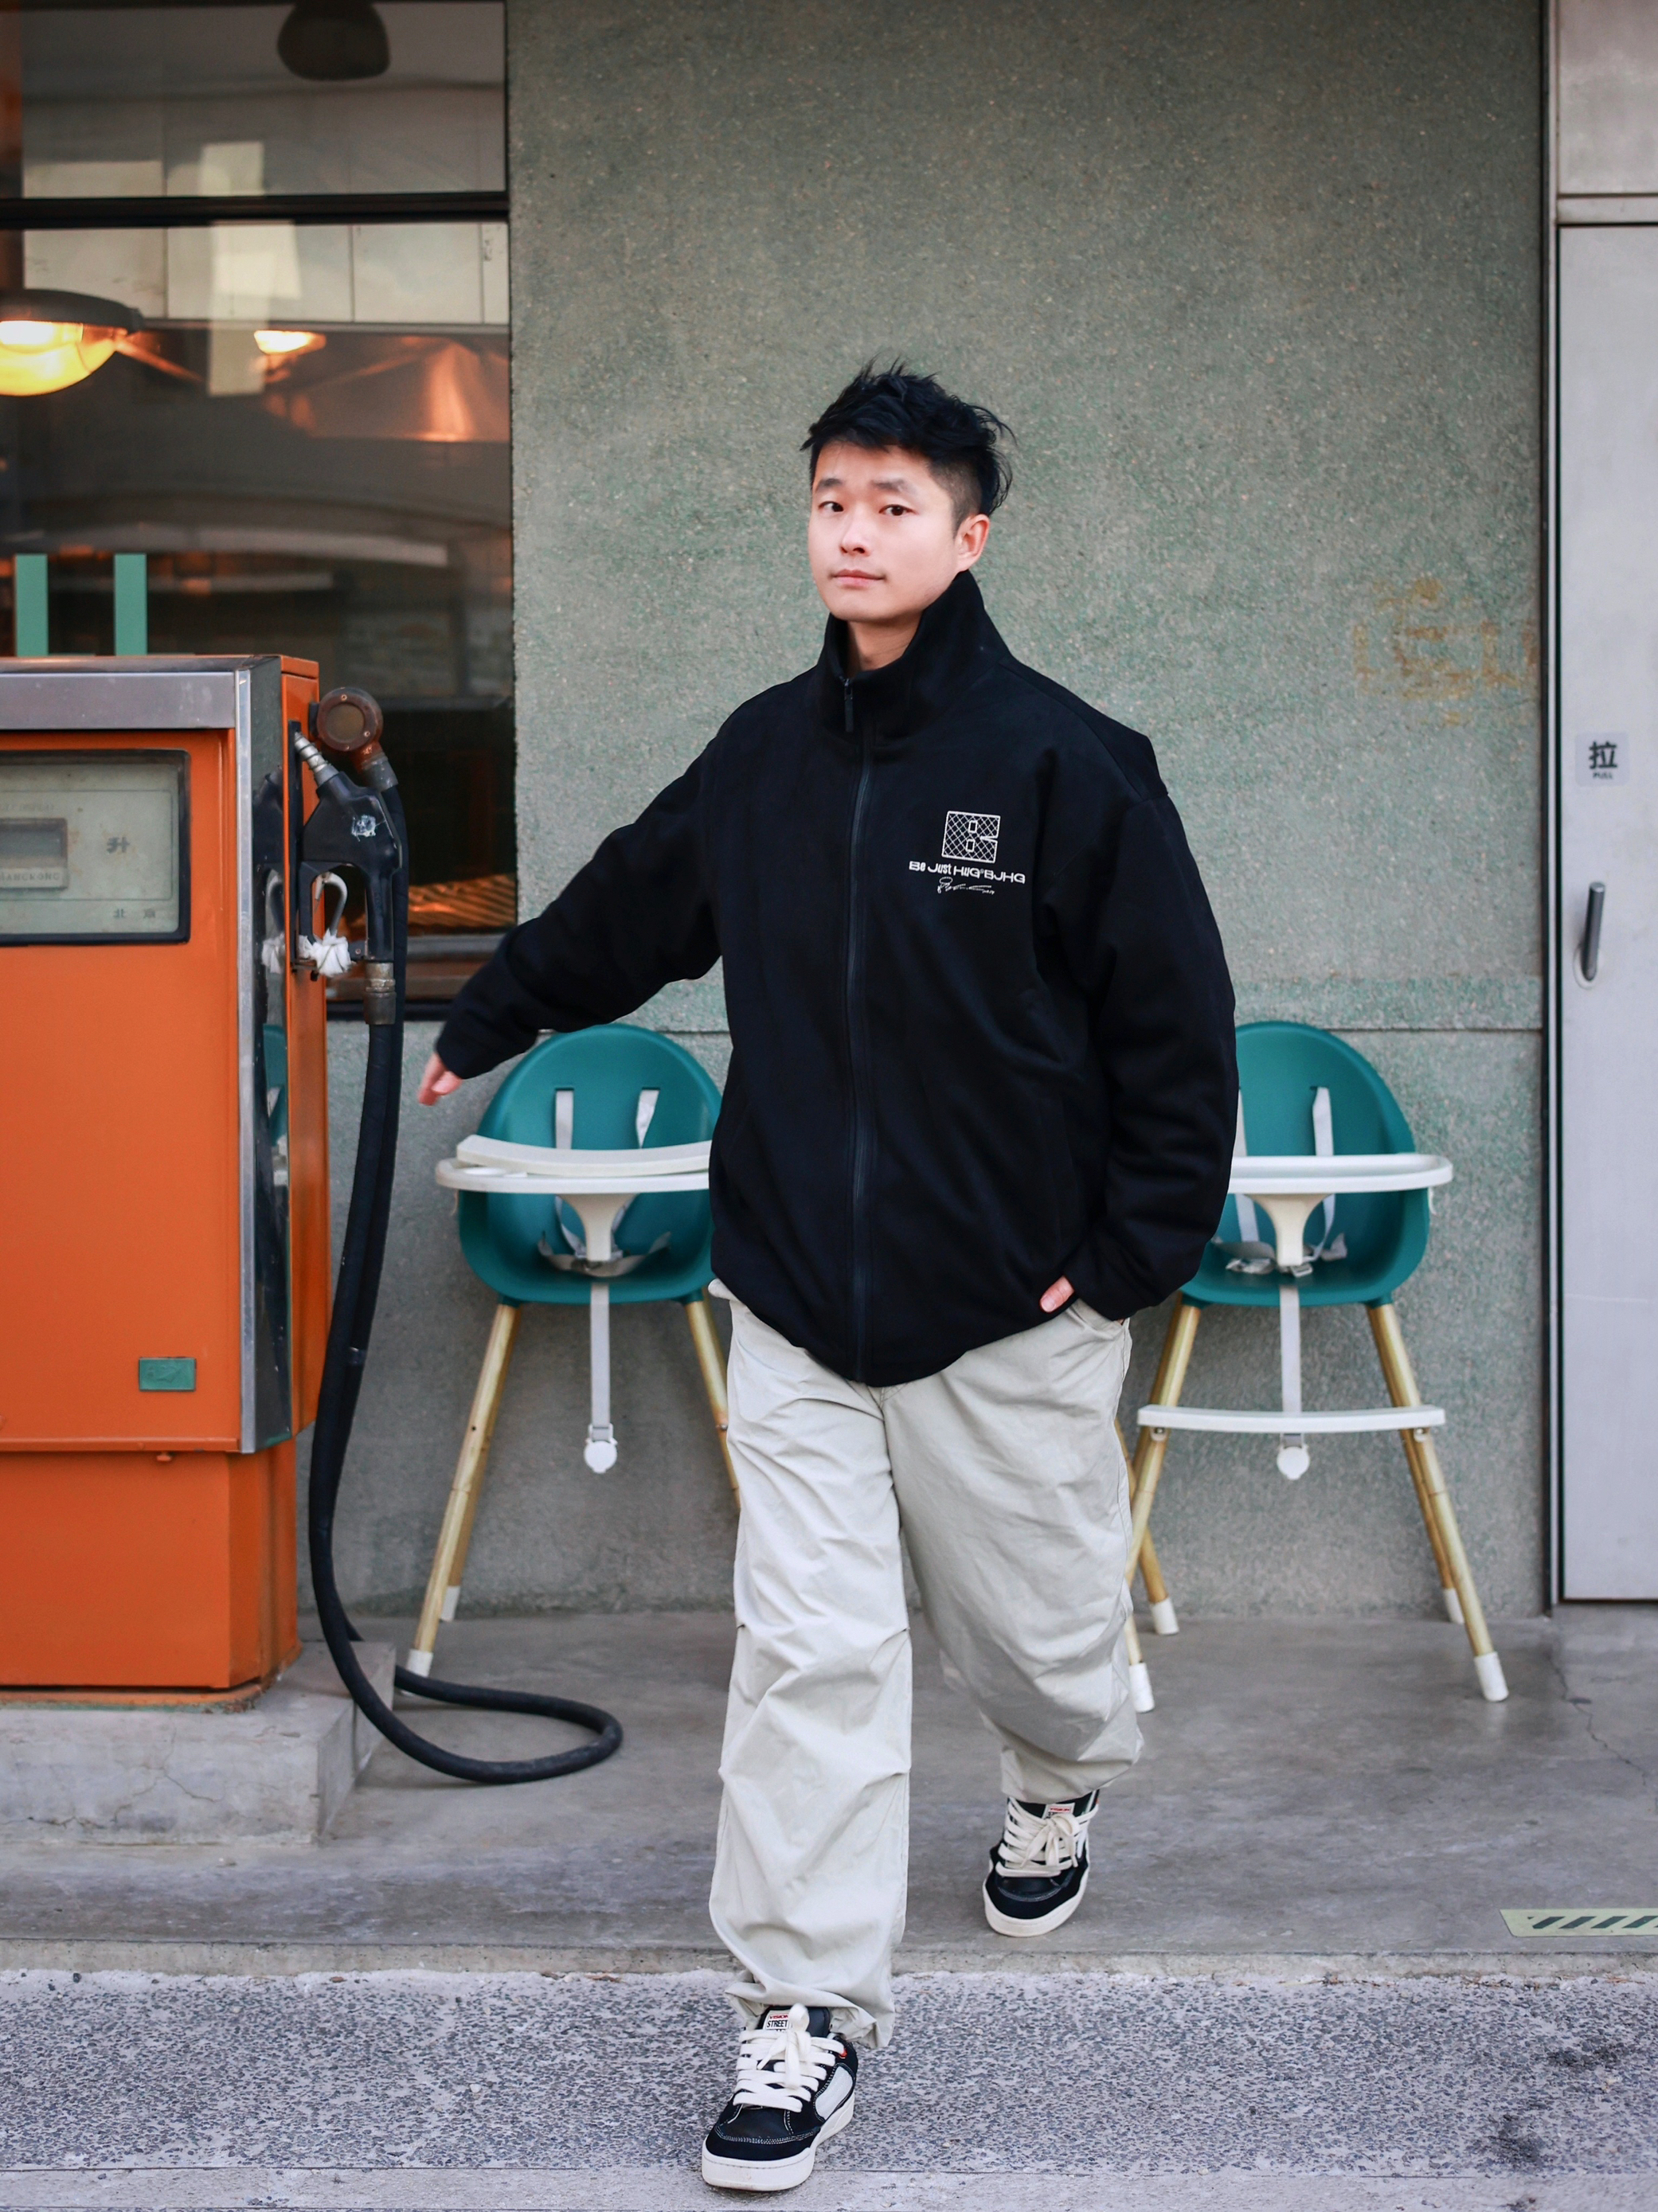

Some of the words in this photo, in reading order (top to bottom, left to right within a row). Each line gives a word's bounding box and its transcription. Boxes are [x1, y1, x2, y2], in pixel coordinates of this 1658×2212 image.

[1589, 741, 1617, 769] 拉
[909, 861, 926, 872] Be
[766, 2019, 788, 2028] STREET
